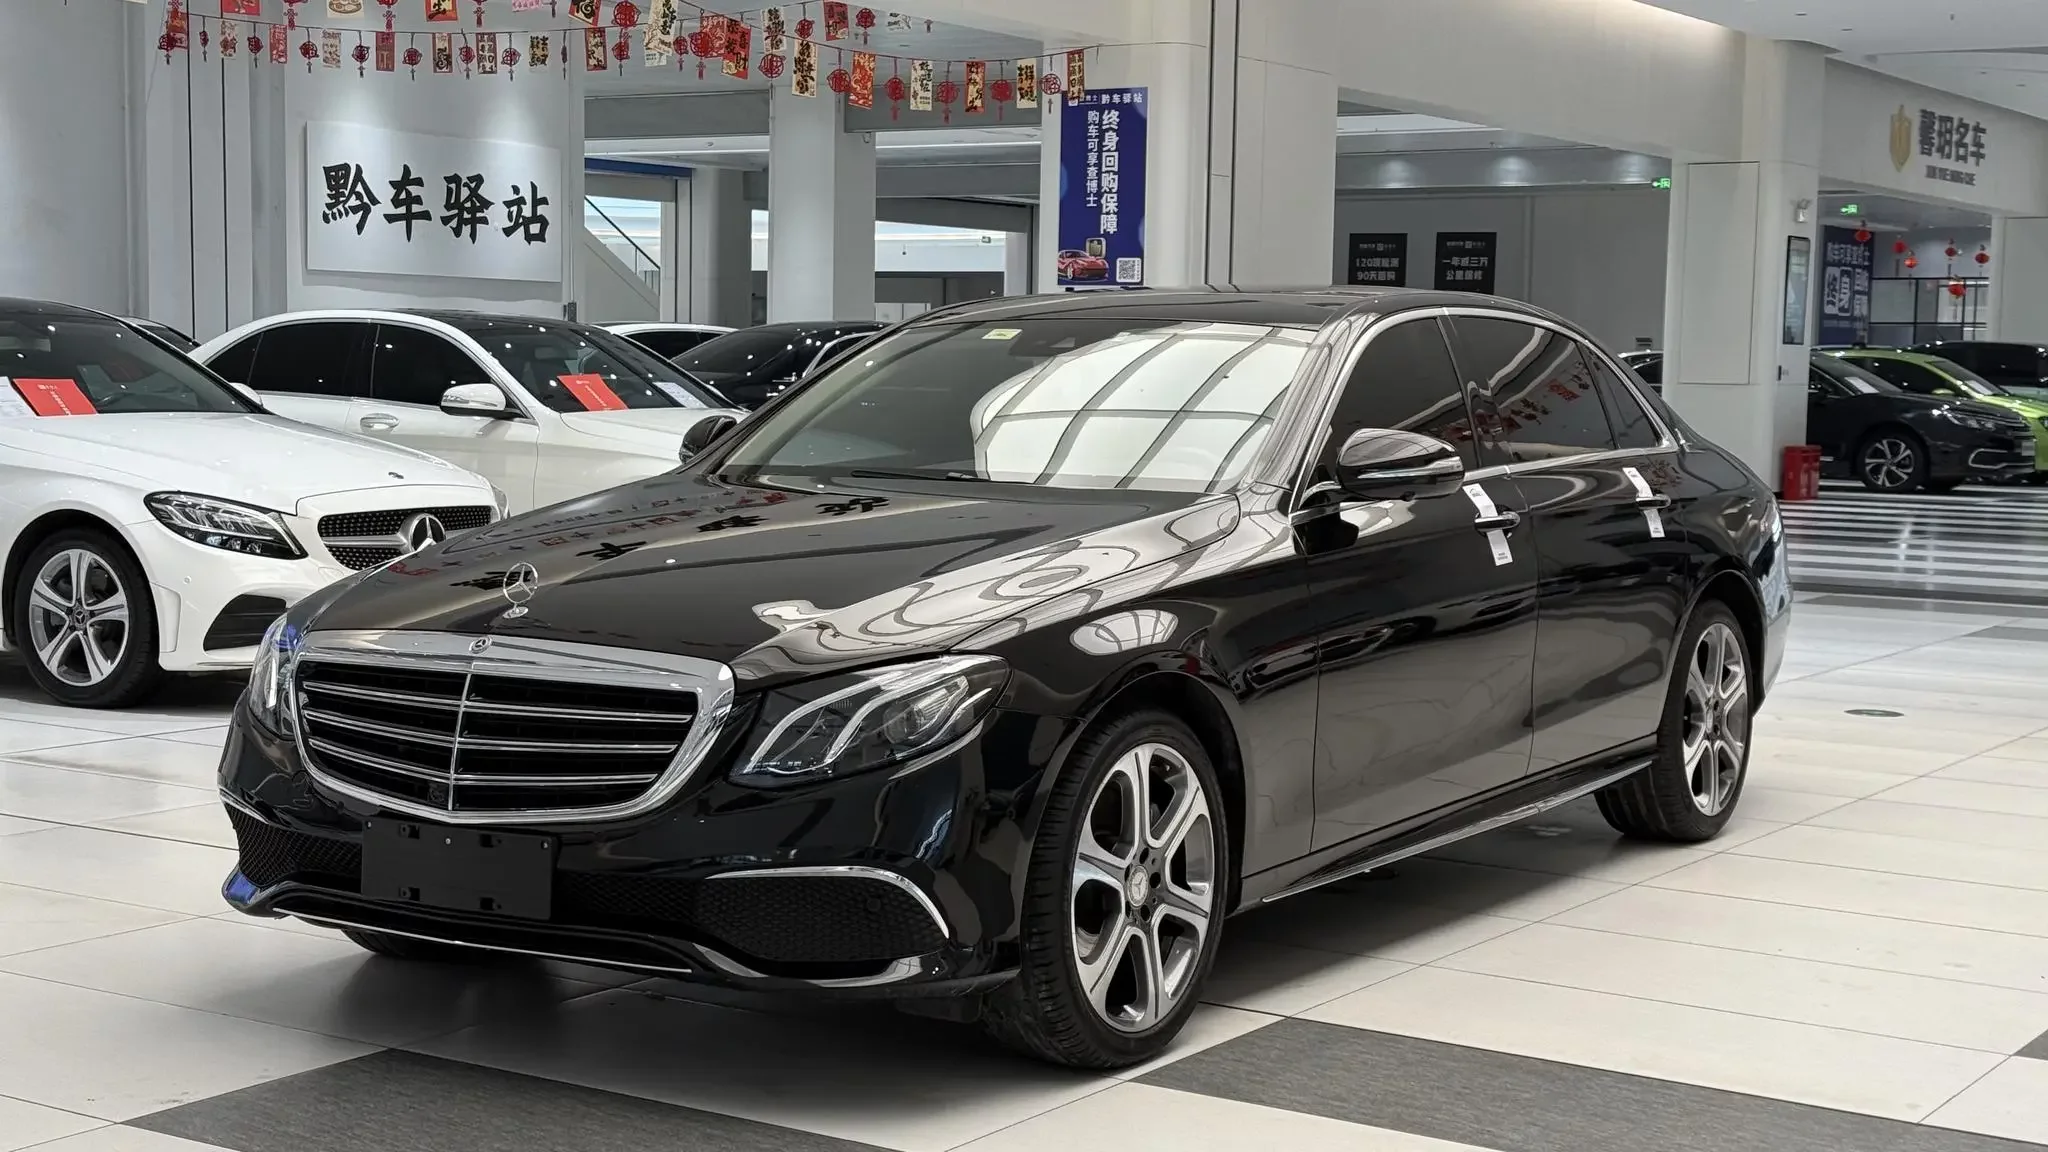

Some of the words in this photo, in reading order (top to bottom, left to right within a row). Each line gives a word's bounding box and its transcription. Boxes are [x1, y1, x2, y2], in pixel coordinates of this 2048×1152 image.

[1101, 93, 1143, 104] 黔车驿站
[1086, 111, 1099, 207] 购车可享查博士
[1101, 110, 1120, 234] 终身回购保障
[323, 163, 550, 244] 黔车驿站
